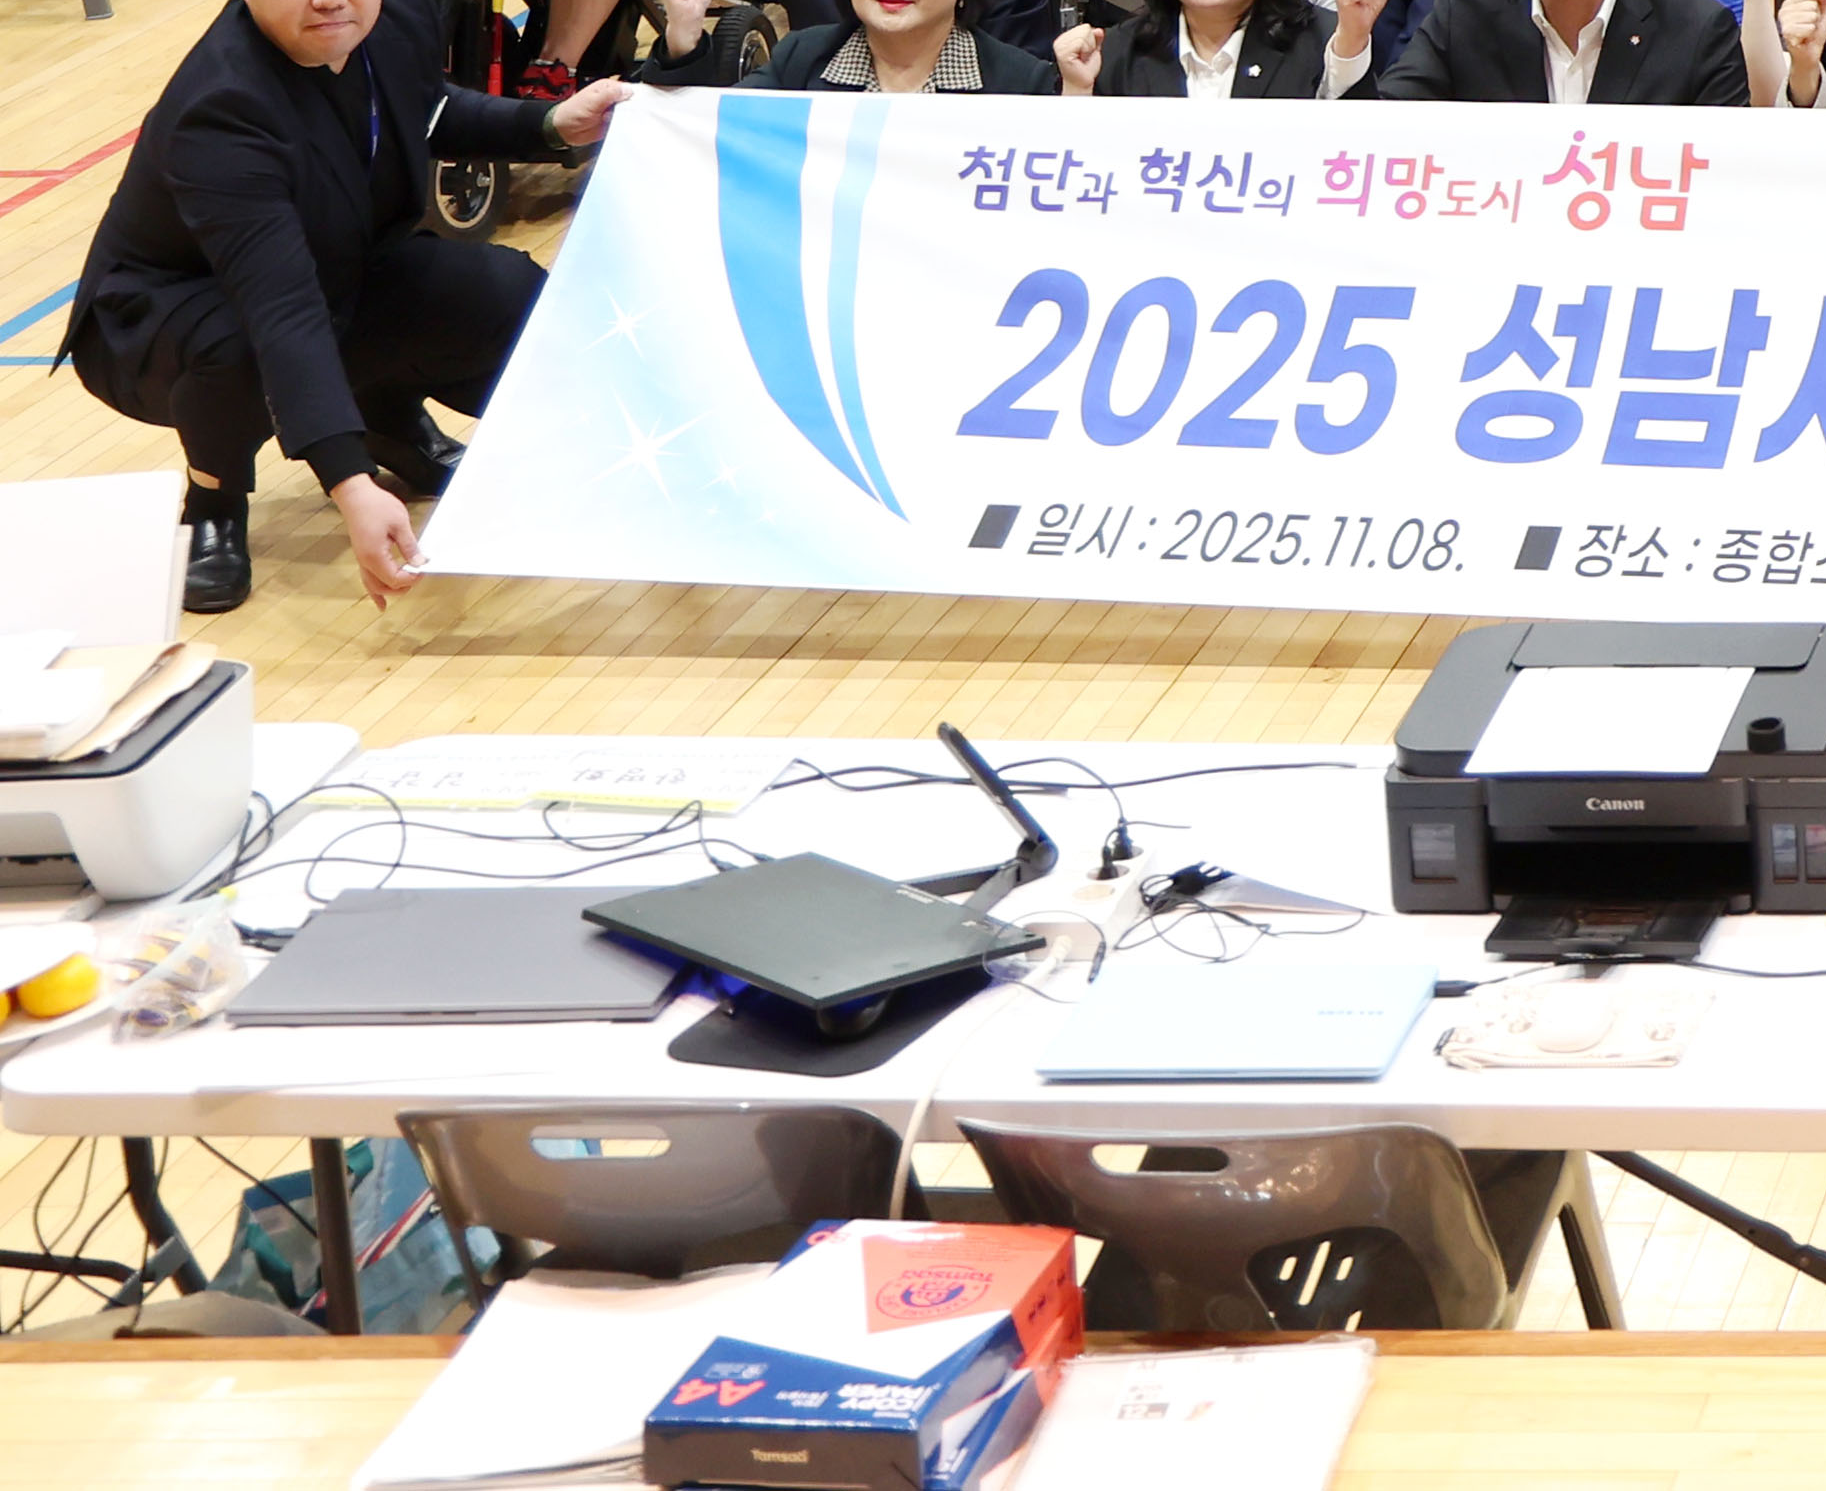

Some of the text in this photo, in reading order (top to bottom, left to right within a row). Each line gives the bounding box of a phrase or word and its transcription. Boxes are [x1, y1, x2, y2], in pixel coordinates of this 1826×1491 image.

[958, 130, 1709, 231] 첨단과 혁신의 희망도시 성남
[957, 268, 1417, 456] 2025
[1160, 511, 1464, 570] 2025.11.08.
[1585, 797, 1645, 811] Canon
[672, 1379, 767, 1406] A4
